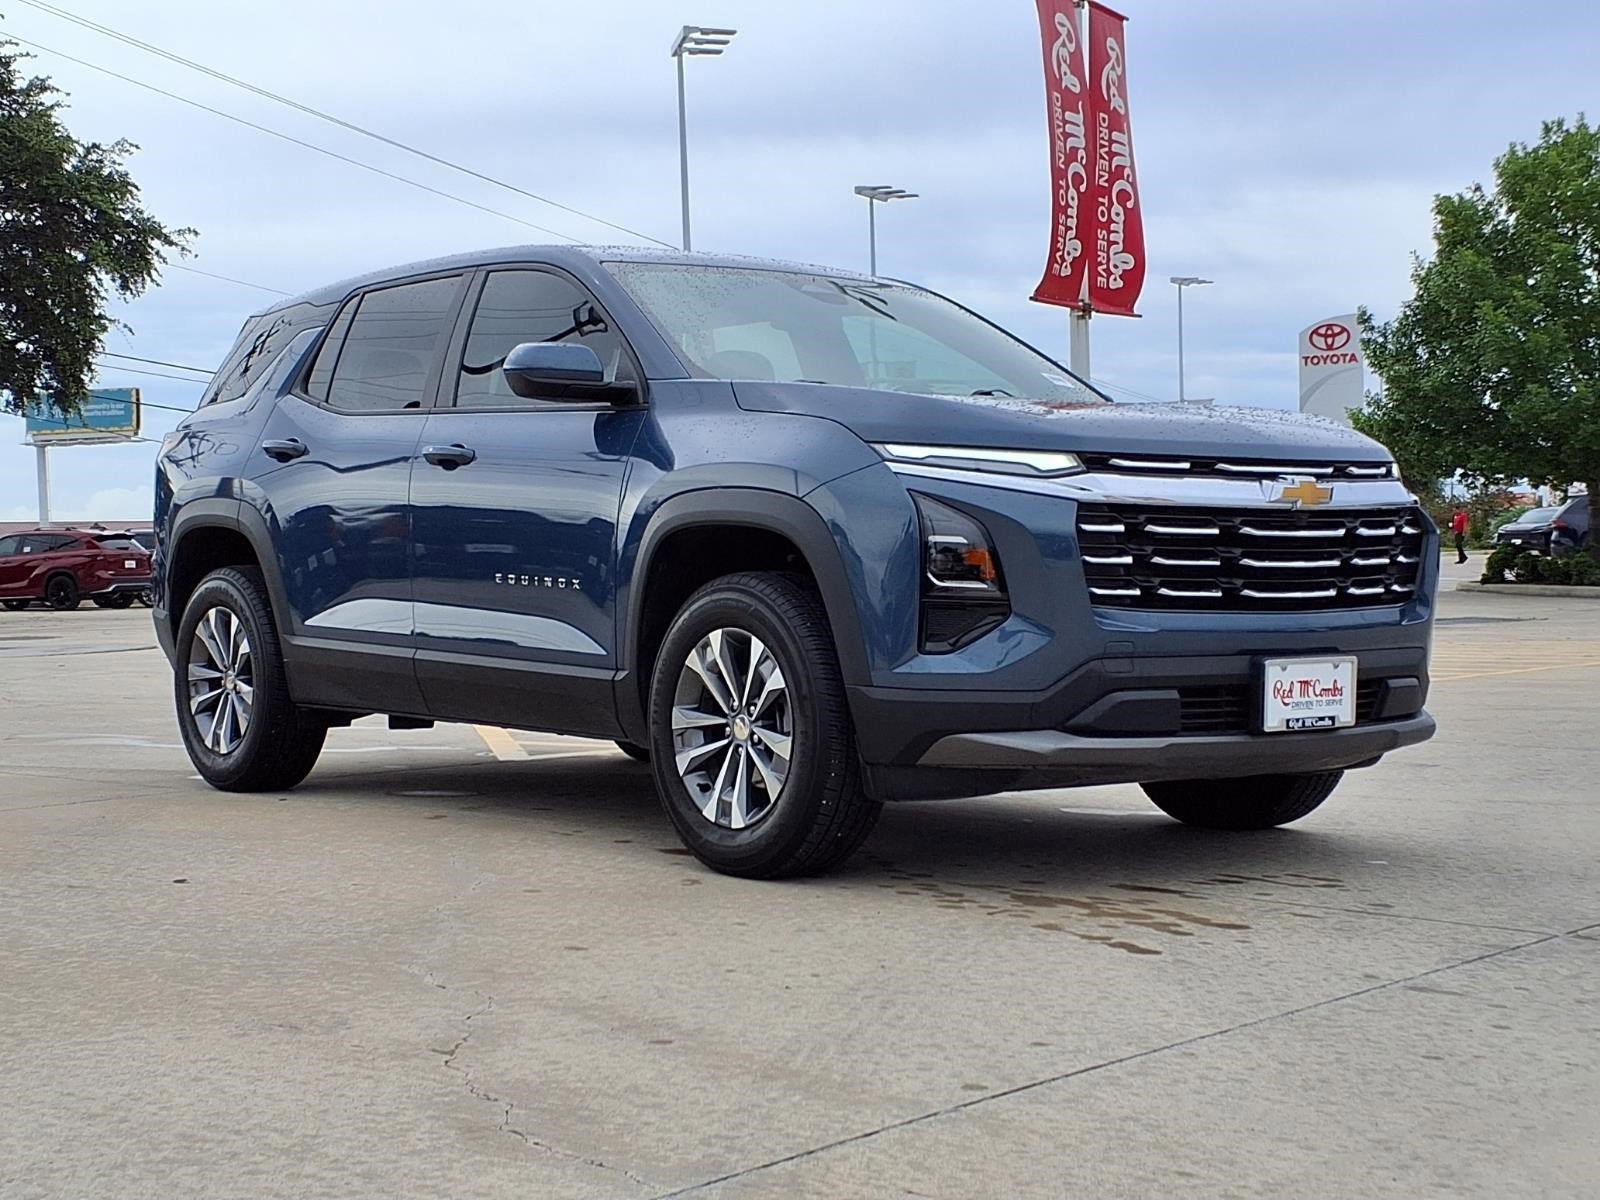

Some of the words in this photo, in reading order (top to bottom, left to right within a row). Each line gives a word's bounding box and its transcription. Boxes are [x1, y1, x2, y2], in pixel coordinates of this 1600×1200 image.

[1052, 12, 1081, 94] Red
[1101, 36, 1126, 115] Red
[1053, 91, 1065, 170] DRIVEN
[1099, 112, 1109, 187] DRIVEN
[1059, 178, 1066, 206] TO
[1060, 100, 1087, 277] McCombs
[1097, 195, 1108, 223] TO
[1109, 122, 1135, 290] McCombs
[1052, 214, 1066, 276] SERVE
[1097, 228, 1108, 289] SERVE
[1302, 352, 1358, 367] TOYOTA
[495, 573, 580, 590] EQUINOX
[1273, 679, 1294, 707] Red
[1291, 700, 1313, 709] DRIVEN
[1315, 700, 1323, 708] TO
[1325, 699, 1343, 707] SERVE
